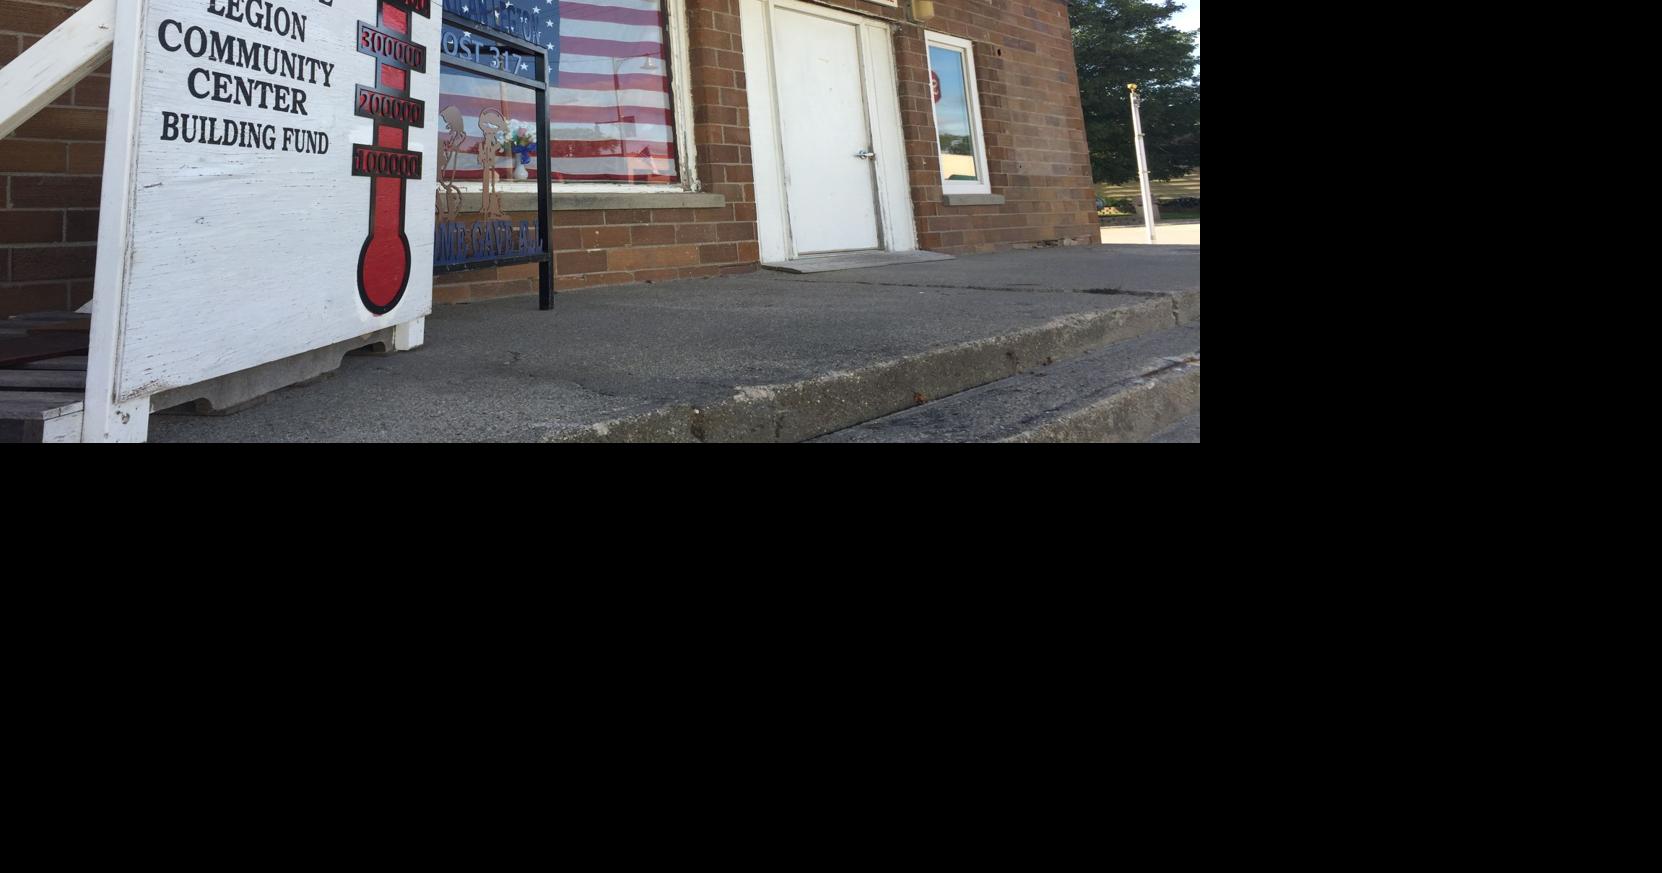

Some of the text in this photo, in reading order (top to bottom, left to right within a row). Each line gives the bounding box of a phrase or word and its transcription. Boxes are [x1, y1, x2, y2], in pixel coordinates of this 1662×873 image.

[158, 19, 335, 88] COMMUNITY
[360, 28, 422, 68] 300000
[441, 31, 522, 75] OST 317
[187, 68, 308, 116] CENTER
[359, 90, 421, 123] 200000
[160, 111, 329, 155] BUILDING FUND
[354, 148, 419, 176] 100000
